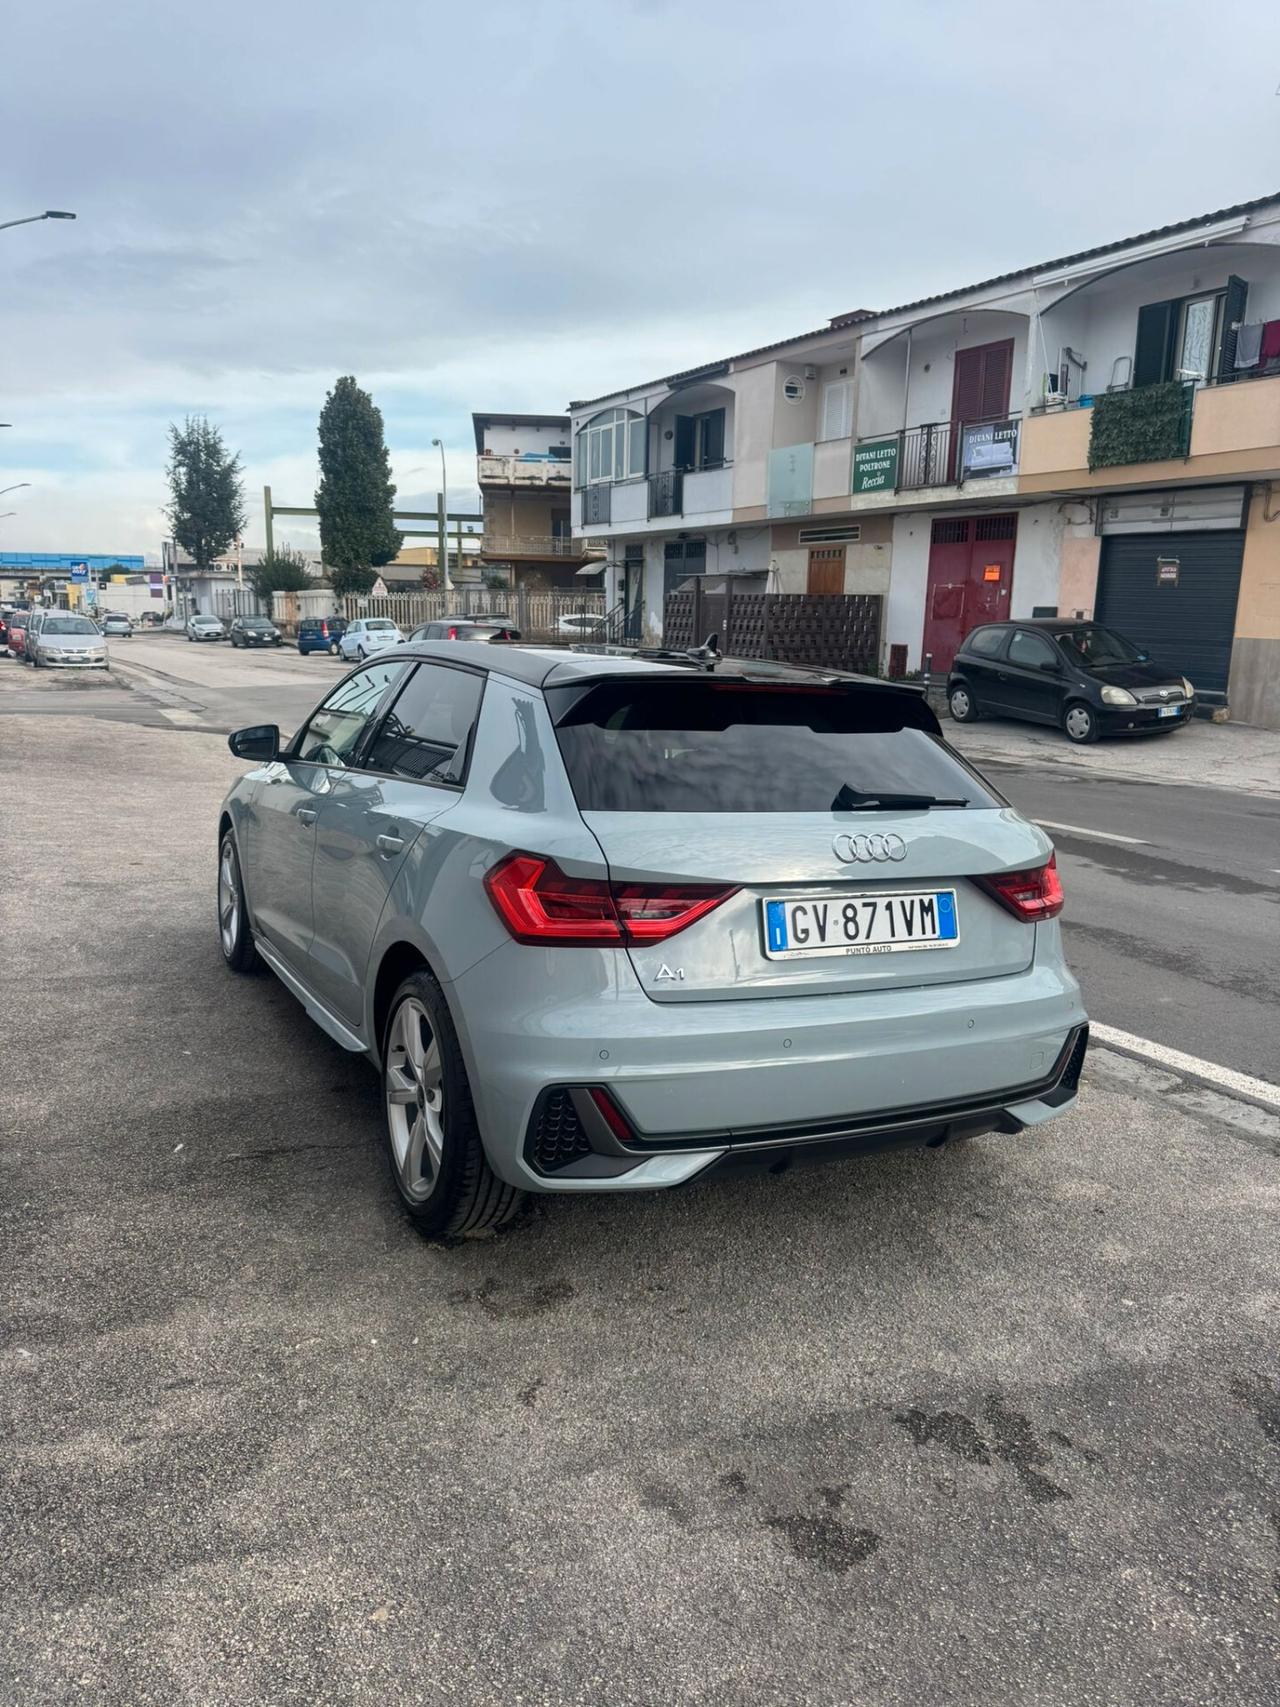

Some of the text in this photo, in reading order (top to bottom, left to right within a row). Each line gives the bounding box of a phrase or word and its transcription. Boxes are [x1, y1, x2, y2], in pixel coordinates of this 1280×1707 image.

[970, 429, 1017, 444] DIVANI LETTO
[855, 448, 896, 462] DIVANI LETTO
[859, 460, 891, 472] POLTRONE
[845, 944, 892, 955] PUNTO AUTO
[654, 963, 685, 981] A1
